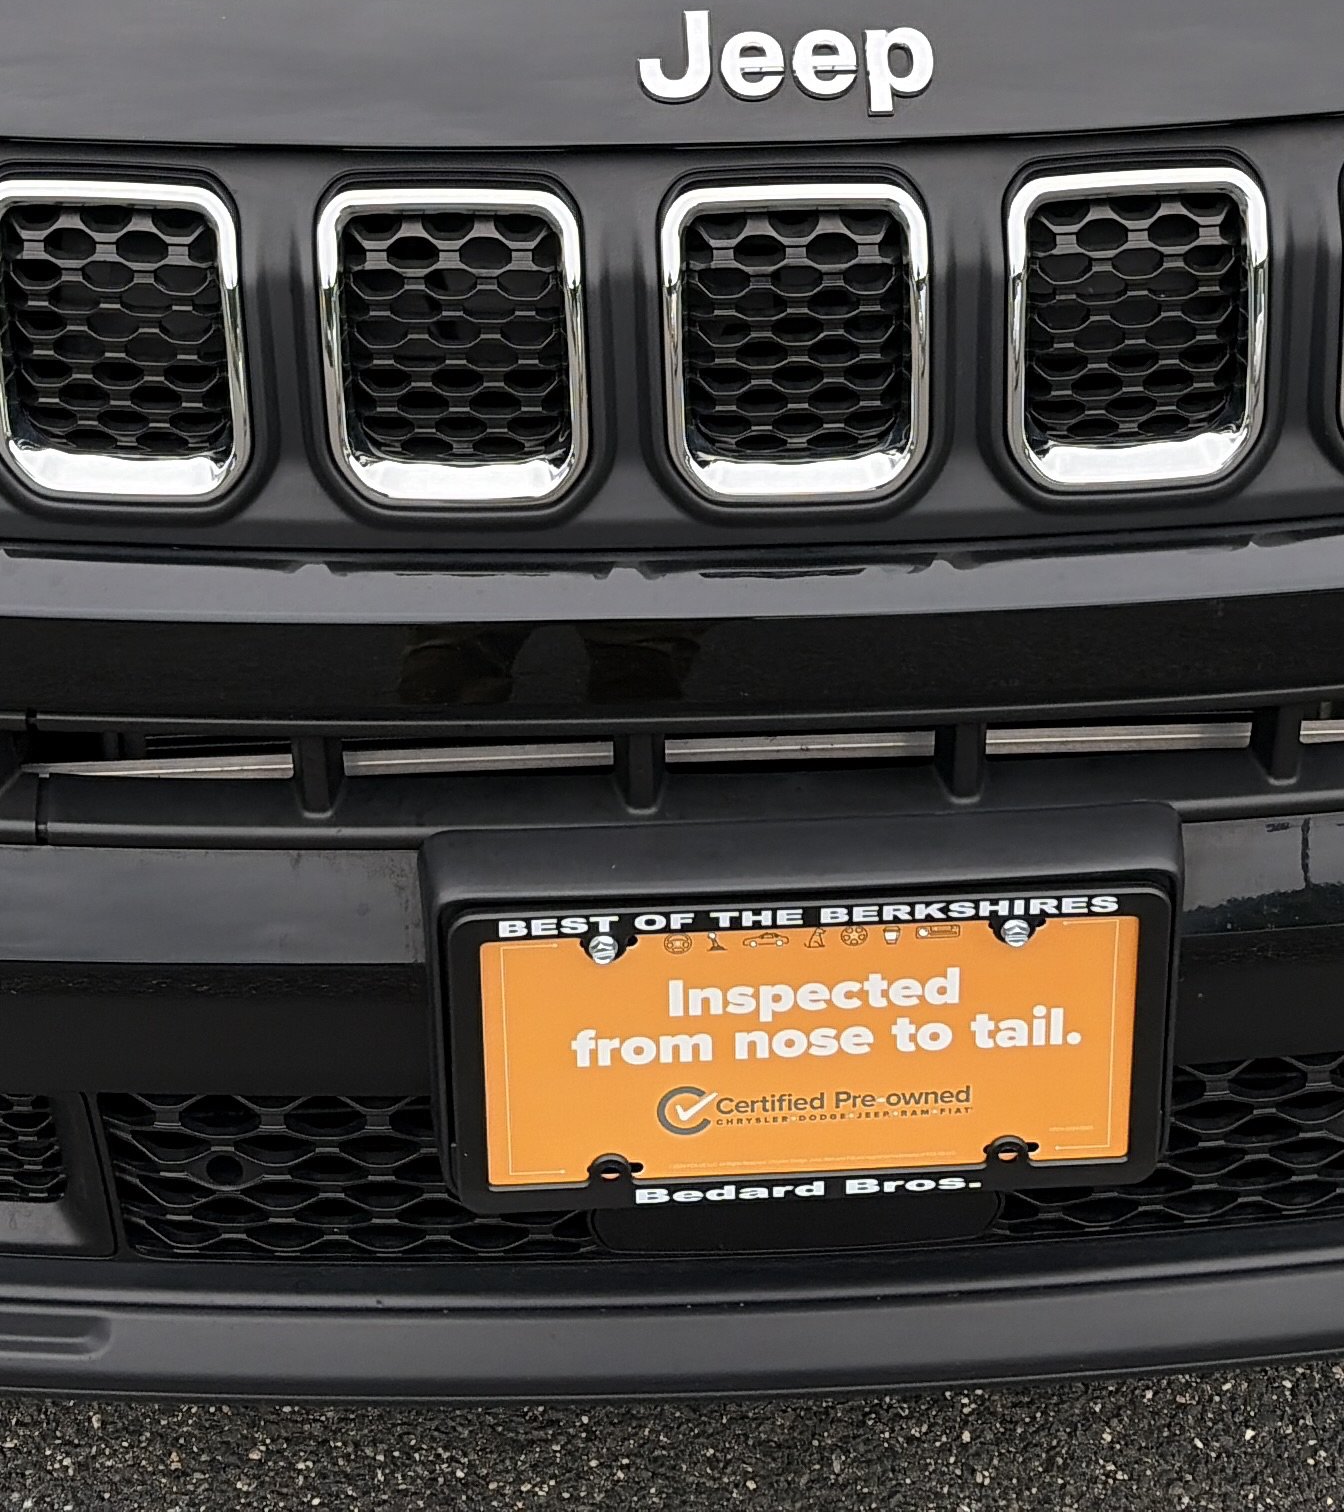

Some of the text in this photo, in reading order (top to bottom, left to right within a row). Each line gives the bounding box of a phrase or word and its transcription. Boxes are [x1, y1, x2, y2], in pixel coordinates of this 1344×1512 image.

[637, 9, 934, 117] Jeep
[498, 895, 1119, 938] BEST OF THE BERKSHIRES
[668, 967, 960, 1022] Inspected
[571, 1005, 1082, 1067] from nose to tail.
[716, 1085, 971, 1115] Certified Pre-owned
[716, 1116, 788, 1126] CHRYSLER
[798, 1113, 846, 1121] DODGE
[857, 1111, 889, 1119] JEEP
[900, 1109, 930, 1117] RAM
[635, 1177, 982, 1204] Bedard Bros.
